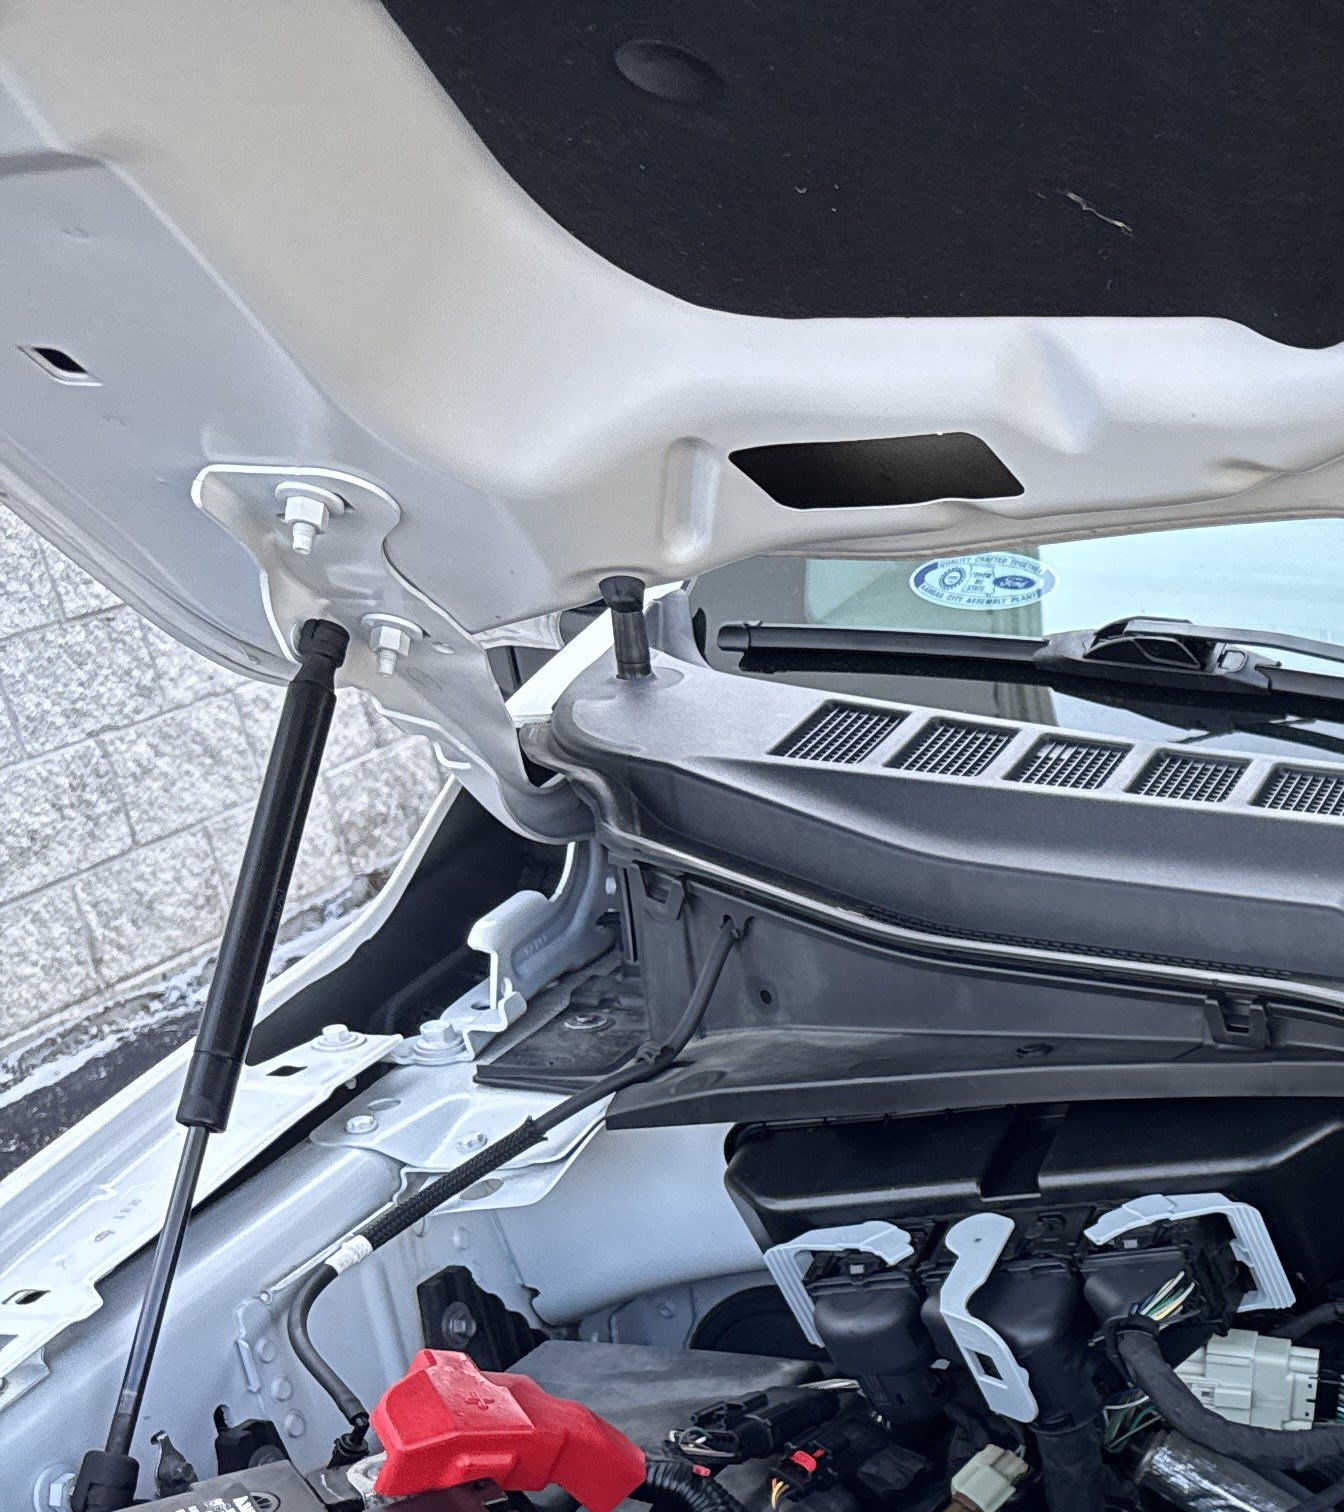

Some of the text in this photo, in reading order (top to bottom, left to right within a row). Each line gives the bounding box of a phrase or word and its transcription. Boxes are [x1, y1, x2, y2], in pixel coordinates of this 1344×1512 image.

[940, 557, 971, 568] QUALITY
[975, 555, 1008, 564] CRAFTED
[1000, 577, 1029, 589] Ford
[921, 584, 1037, 605] KANSAS CITY ASSEMBLY PLANT
